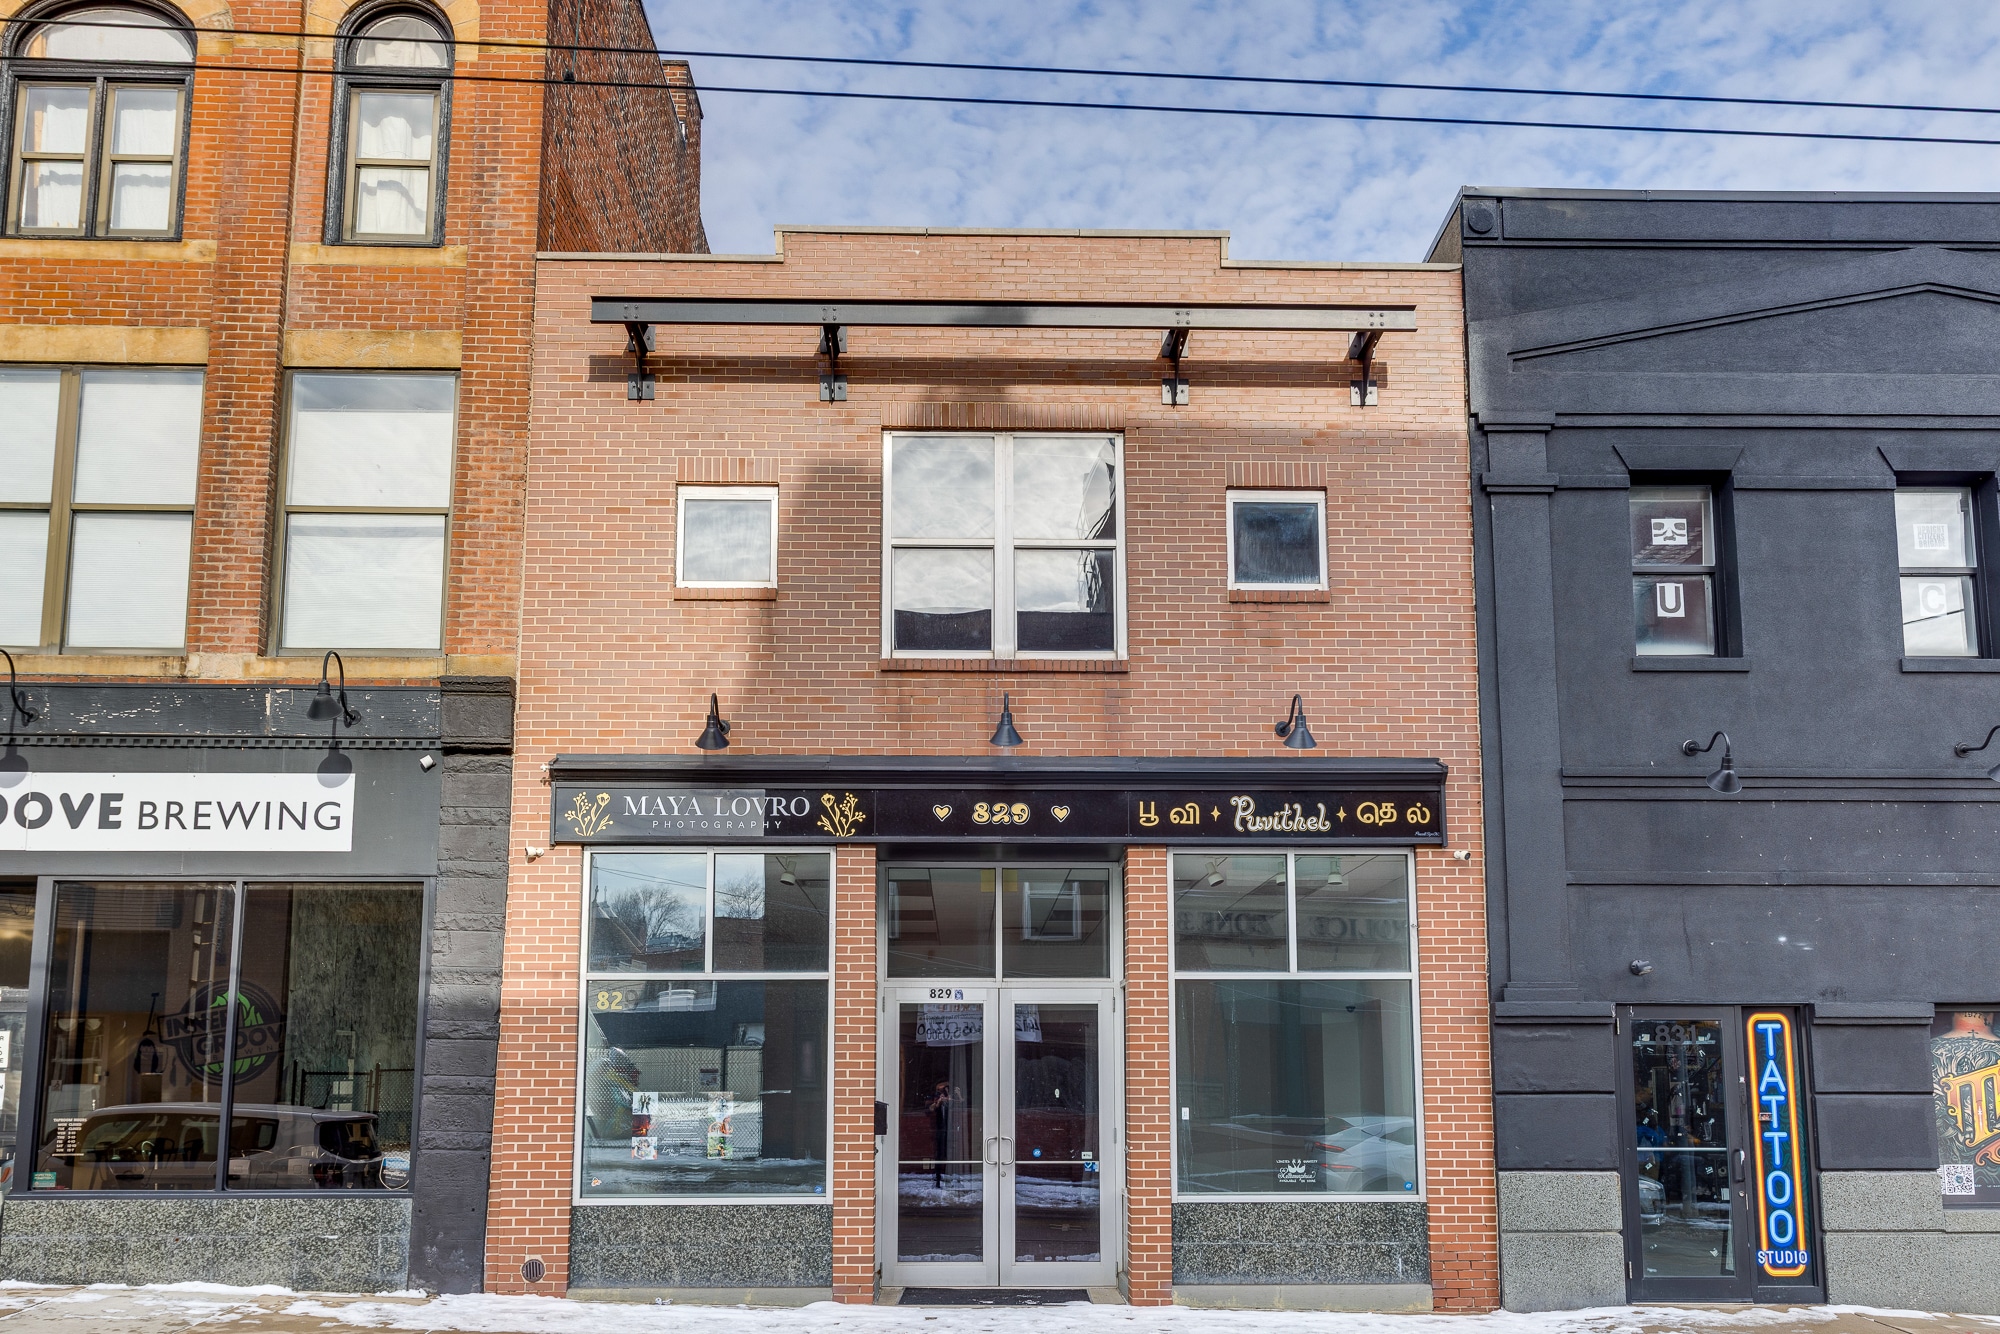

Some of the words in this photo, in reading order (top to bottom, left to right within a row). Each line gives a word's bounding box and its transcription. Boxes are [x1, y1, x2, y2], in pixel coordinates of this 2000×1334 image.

[1658, 585, 1682, 614] U
[1920, 585, 1946, 615] C
[0, 791, 124, 830] OVE
[138, 800, 342, 831] BREWING
[623, 795, 703, 817] MAYA
[713, 795, 810, 817] LOVRO
[972, 801, 1031, 825] 829
[1230, 795, 1332, 833] Puvithel
[652, 820, 782, 829] PHOTOGRAPHY
[929, 988, 952, 999] 829
[1655, 1024, 1697, 1046] 831
[1756, 1022, 1795, 1245] TATTOO
[1757, 1250, 1808, 1265] STUDIO
